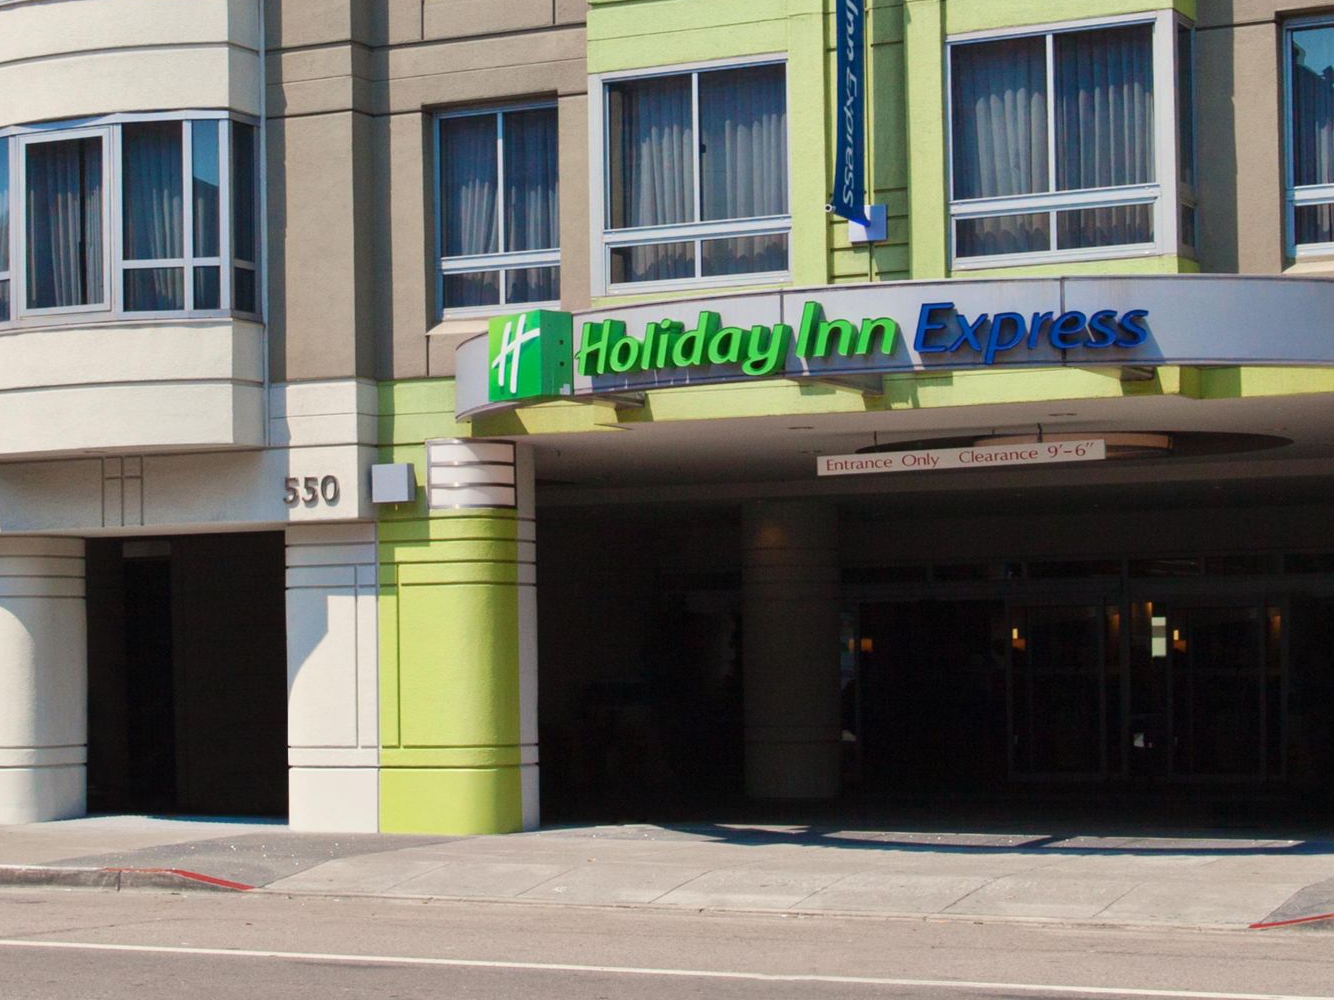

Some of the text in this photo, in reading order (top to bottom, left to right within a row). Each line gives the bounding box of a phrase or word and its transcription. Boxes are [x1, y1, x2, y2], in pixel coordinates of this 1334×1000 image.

[842, 67, 858, 208] Express
[575, 301, 1149, 376] Holiday Inn Express
[825, 457, 893, 472] Entrance
[901, 453, 940, 468] Only
[958, 449, 1039, 465] Clearance
[283, 475, 339, 506] 550
